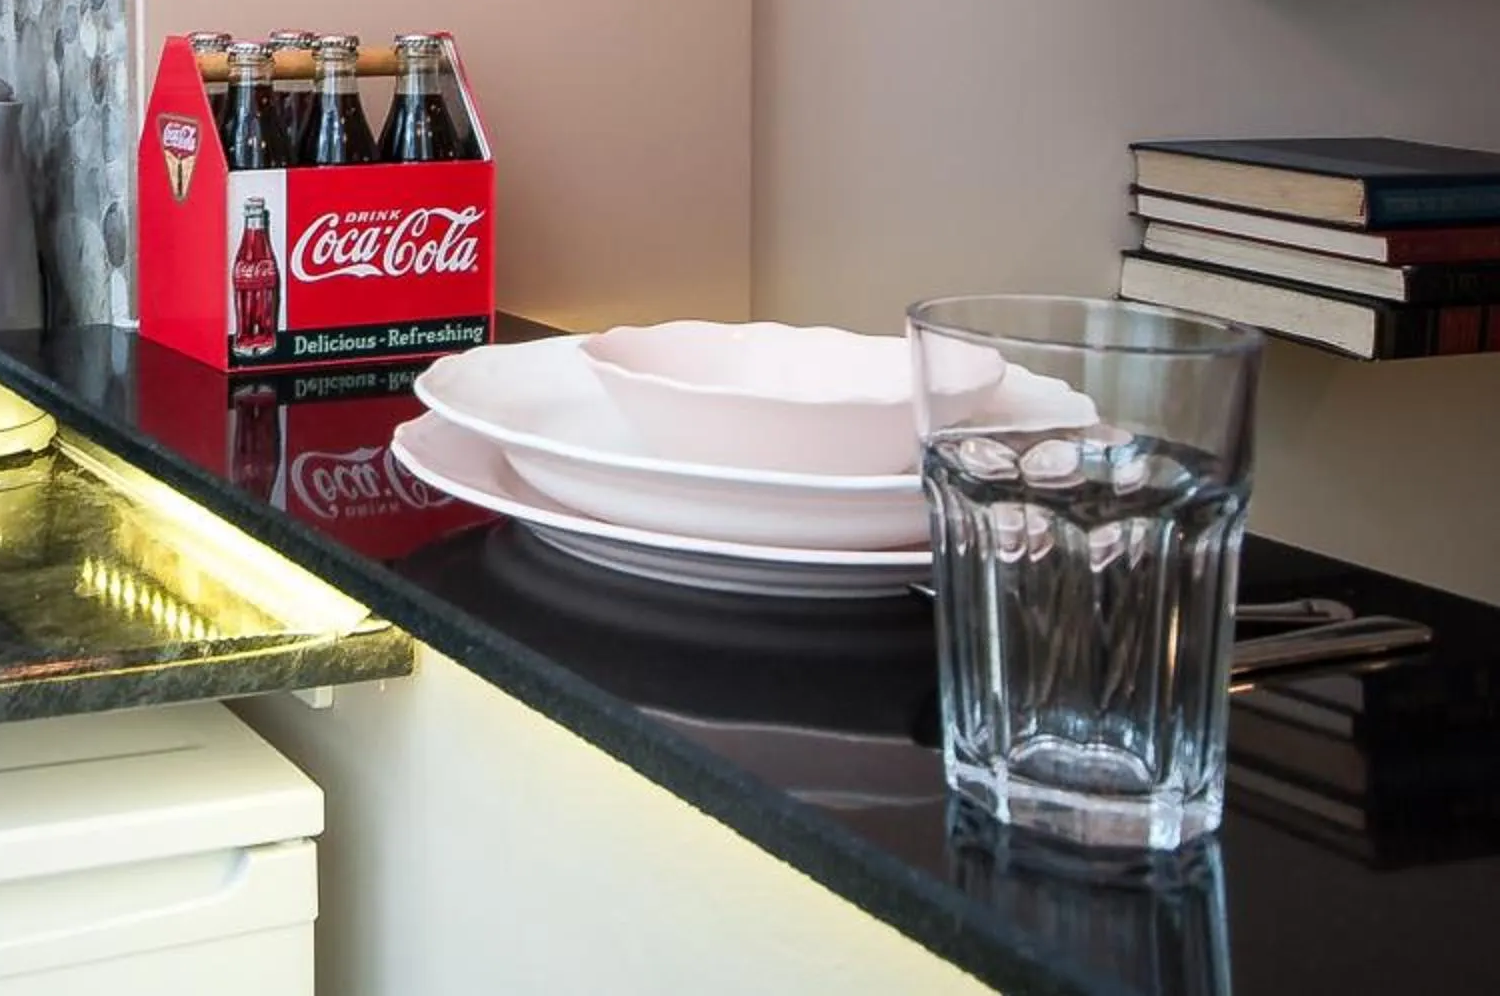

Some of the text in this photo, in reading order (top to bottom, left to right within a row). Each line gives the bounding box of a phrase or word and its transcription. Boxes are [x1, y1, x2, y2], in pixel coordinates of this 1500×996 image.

[344, 210, 402, 223] DRINK
[290, 206, 485, 282] Coca-Cola
[294, 333, 377, 355] Delicious
[387, 324, 485, 348] Refreshing
